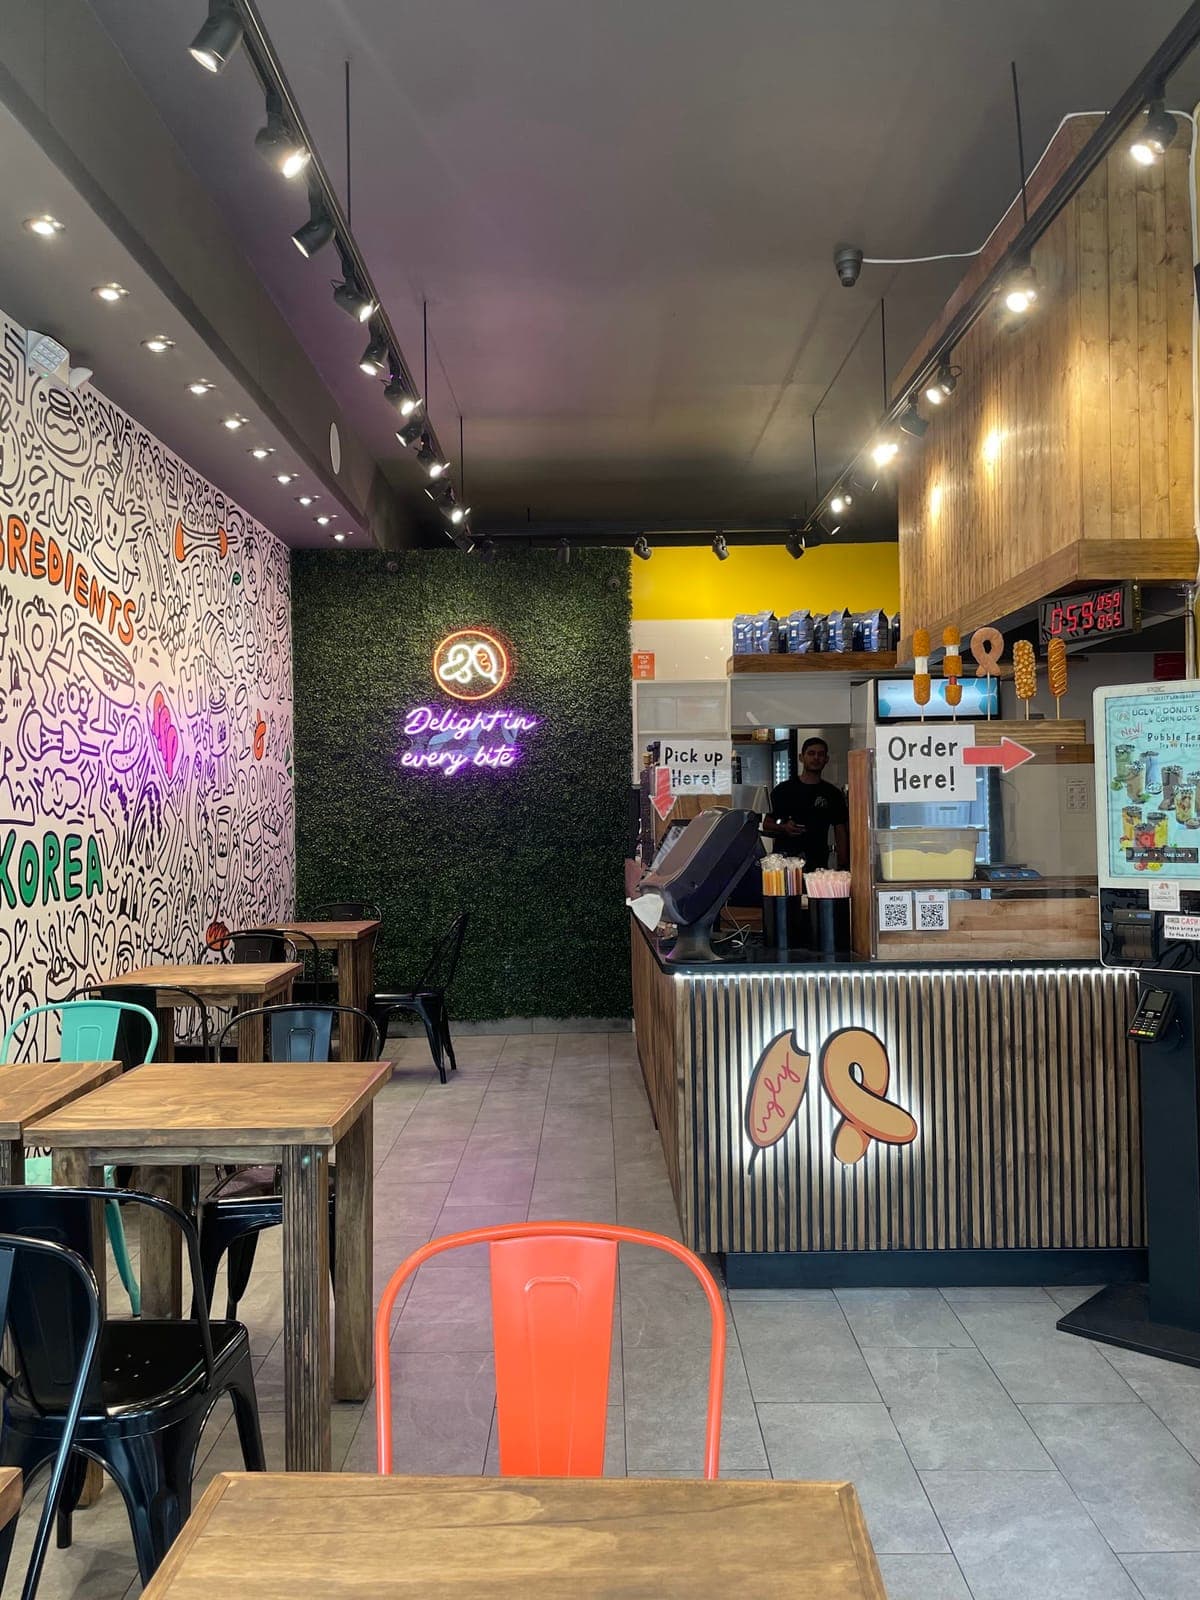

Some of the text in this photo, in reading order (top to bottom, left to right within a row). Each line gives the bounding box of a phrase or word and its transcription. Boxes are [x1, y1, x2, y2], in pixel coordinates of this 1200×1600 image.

[0, 514, 136, 646] REDIENTS
[192, 563, 228, 622] FOOD
[404, 707, 537, 739] Delight in
[1132, 705, 1200, 717] UGLY DONUTS
[402, 744, 515, 775] every bite
[665, 746, 723, 766] Pick up
[888, 736, 958, 761] Order
[672, 769, 716, 787] Here!
[894, 766, 955, 792] Here!
[0, 829, 104, 909] KOREA
[757, 1052, 800, 1133] ugly
